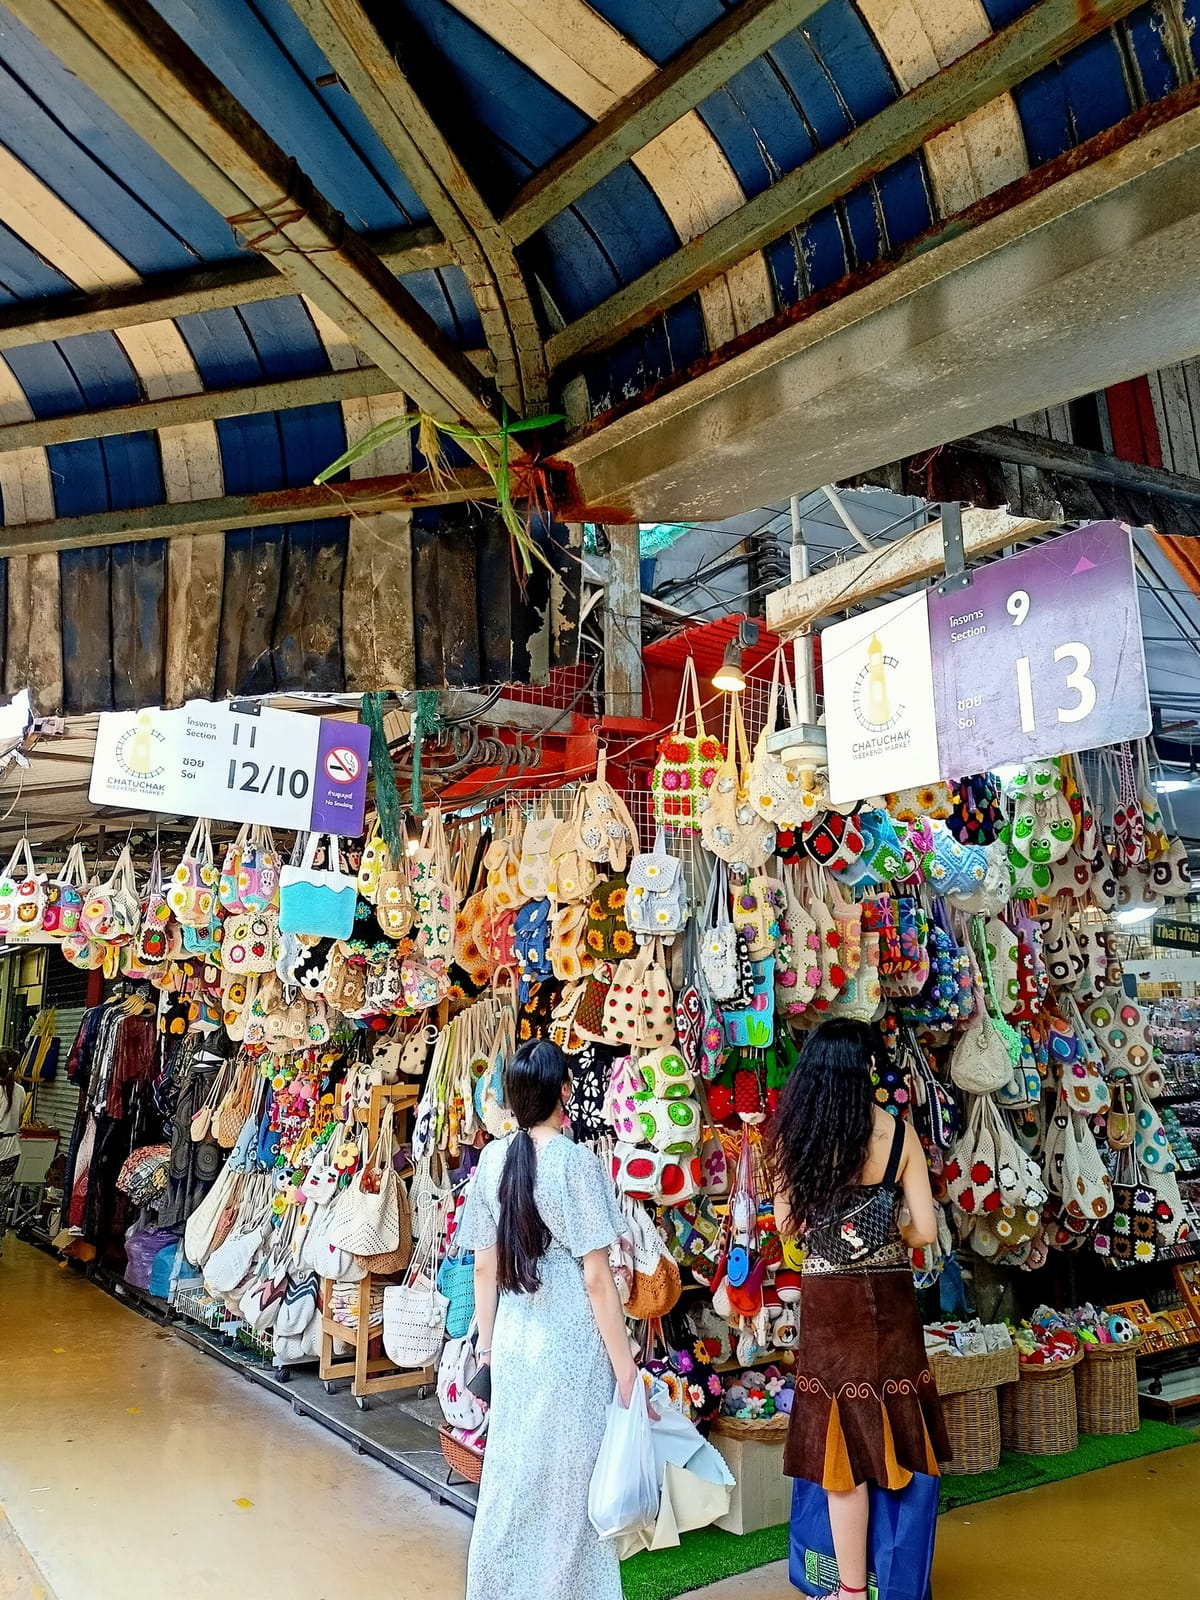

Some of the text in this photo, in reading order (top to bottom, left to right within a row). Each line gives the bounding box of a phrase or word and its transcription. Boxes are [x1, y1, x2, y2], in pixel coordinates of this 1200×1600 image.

[1006, 590, 1030, 626] 9
[949, 609, 984, 628] โครงการ
[951, 625, 986, 643] Section
[1015, 641, 1098, 733] 13
[957, 695, 982, 711] ซอย
[187, 716, 217, 730] โครงการ
[959, 715, 976, 729] Soi
[186, 728, 217, 740] Section
[233, 723, 257, 749] 11
[852, 729, 911, 753] CHATUCHAK
[853, 740, 911, 760] WEEKEND MARKET
[182, 757, 205, 768] ซอย
[181, 769, 196, 779] Soi
[228, 759, 309, 799] 12/10
[106, 784, 164, 797] WEEKEND MARKET
[107, 776, 166, 791] CHATUCHAK
[333, 800, 353, 810] Smoking
[1156, 923, 1177, 940] Thai
